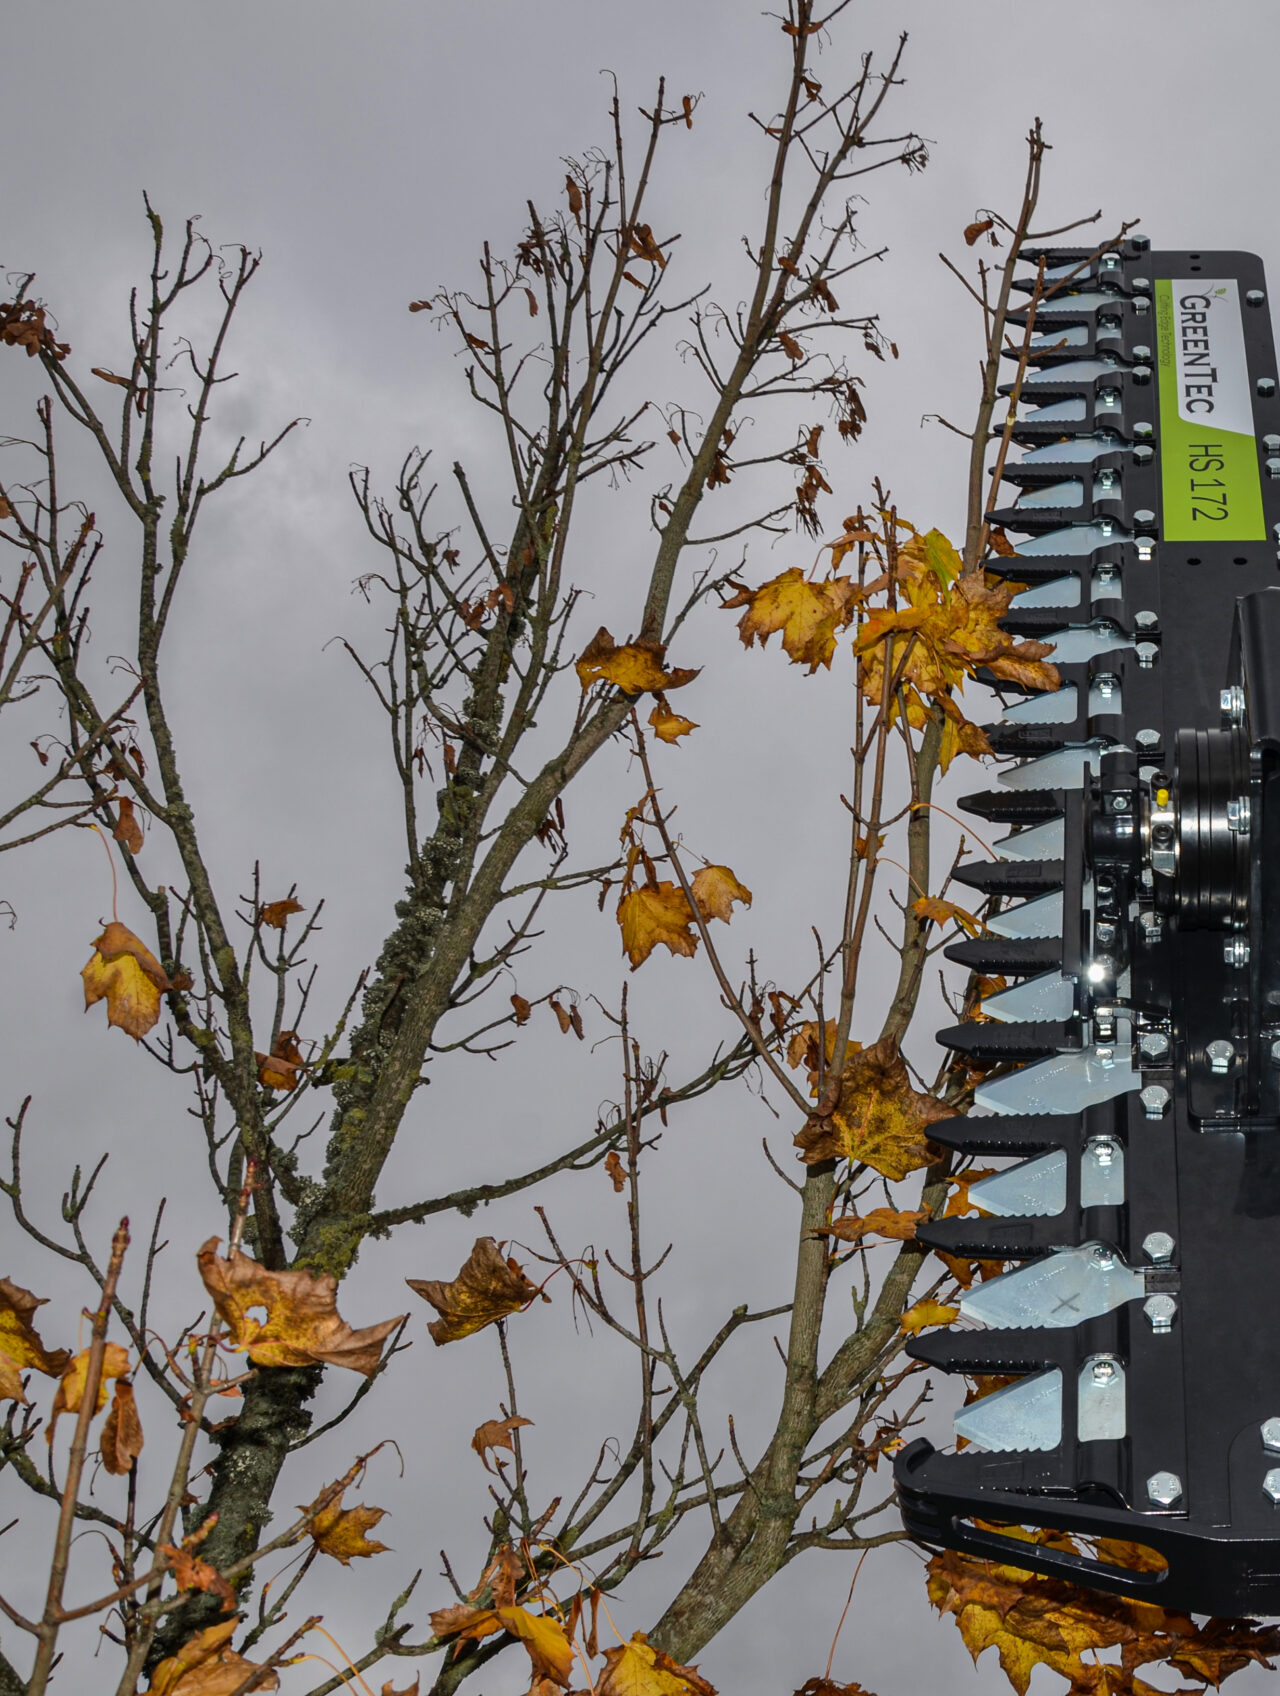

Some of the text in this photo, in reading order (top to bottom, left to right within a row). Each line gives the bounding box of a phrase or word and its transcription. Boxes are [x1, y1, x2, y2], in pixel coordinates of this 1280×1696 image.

[1158, 316, 1171, 331] Edge
[1159, 332, 1172, 368] Technology
[1179, 294, 1218, 414] GREENTEC
[1188, 444, 1229, 521] HS 172
